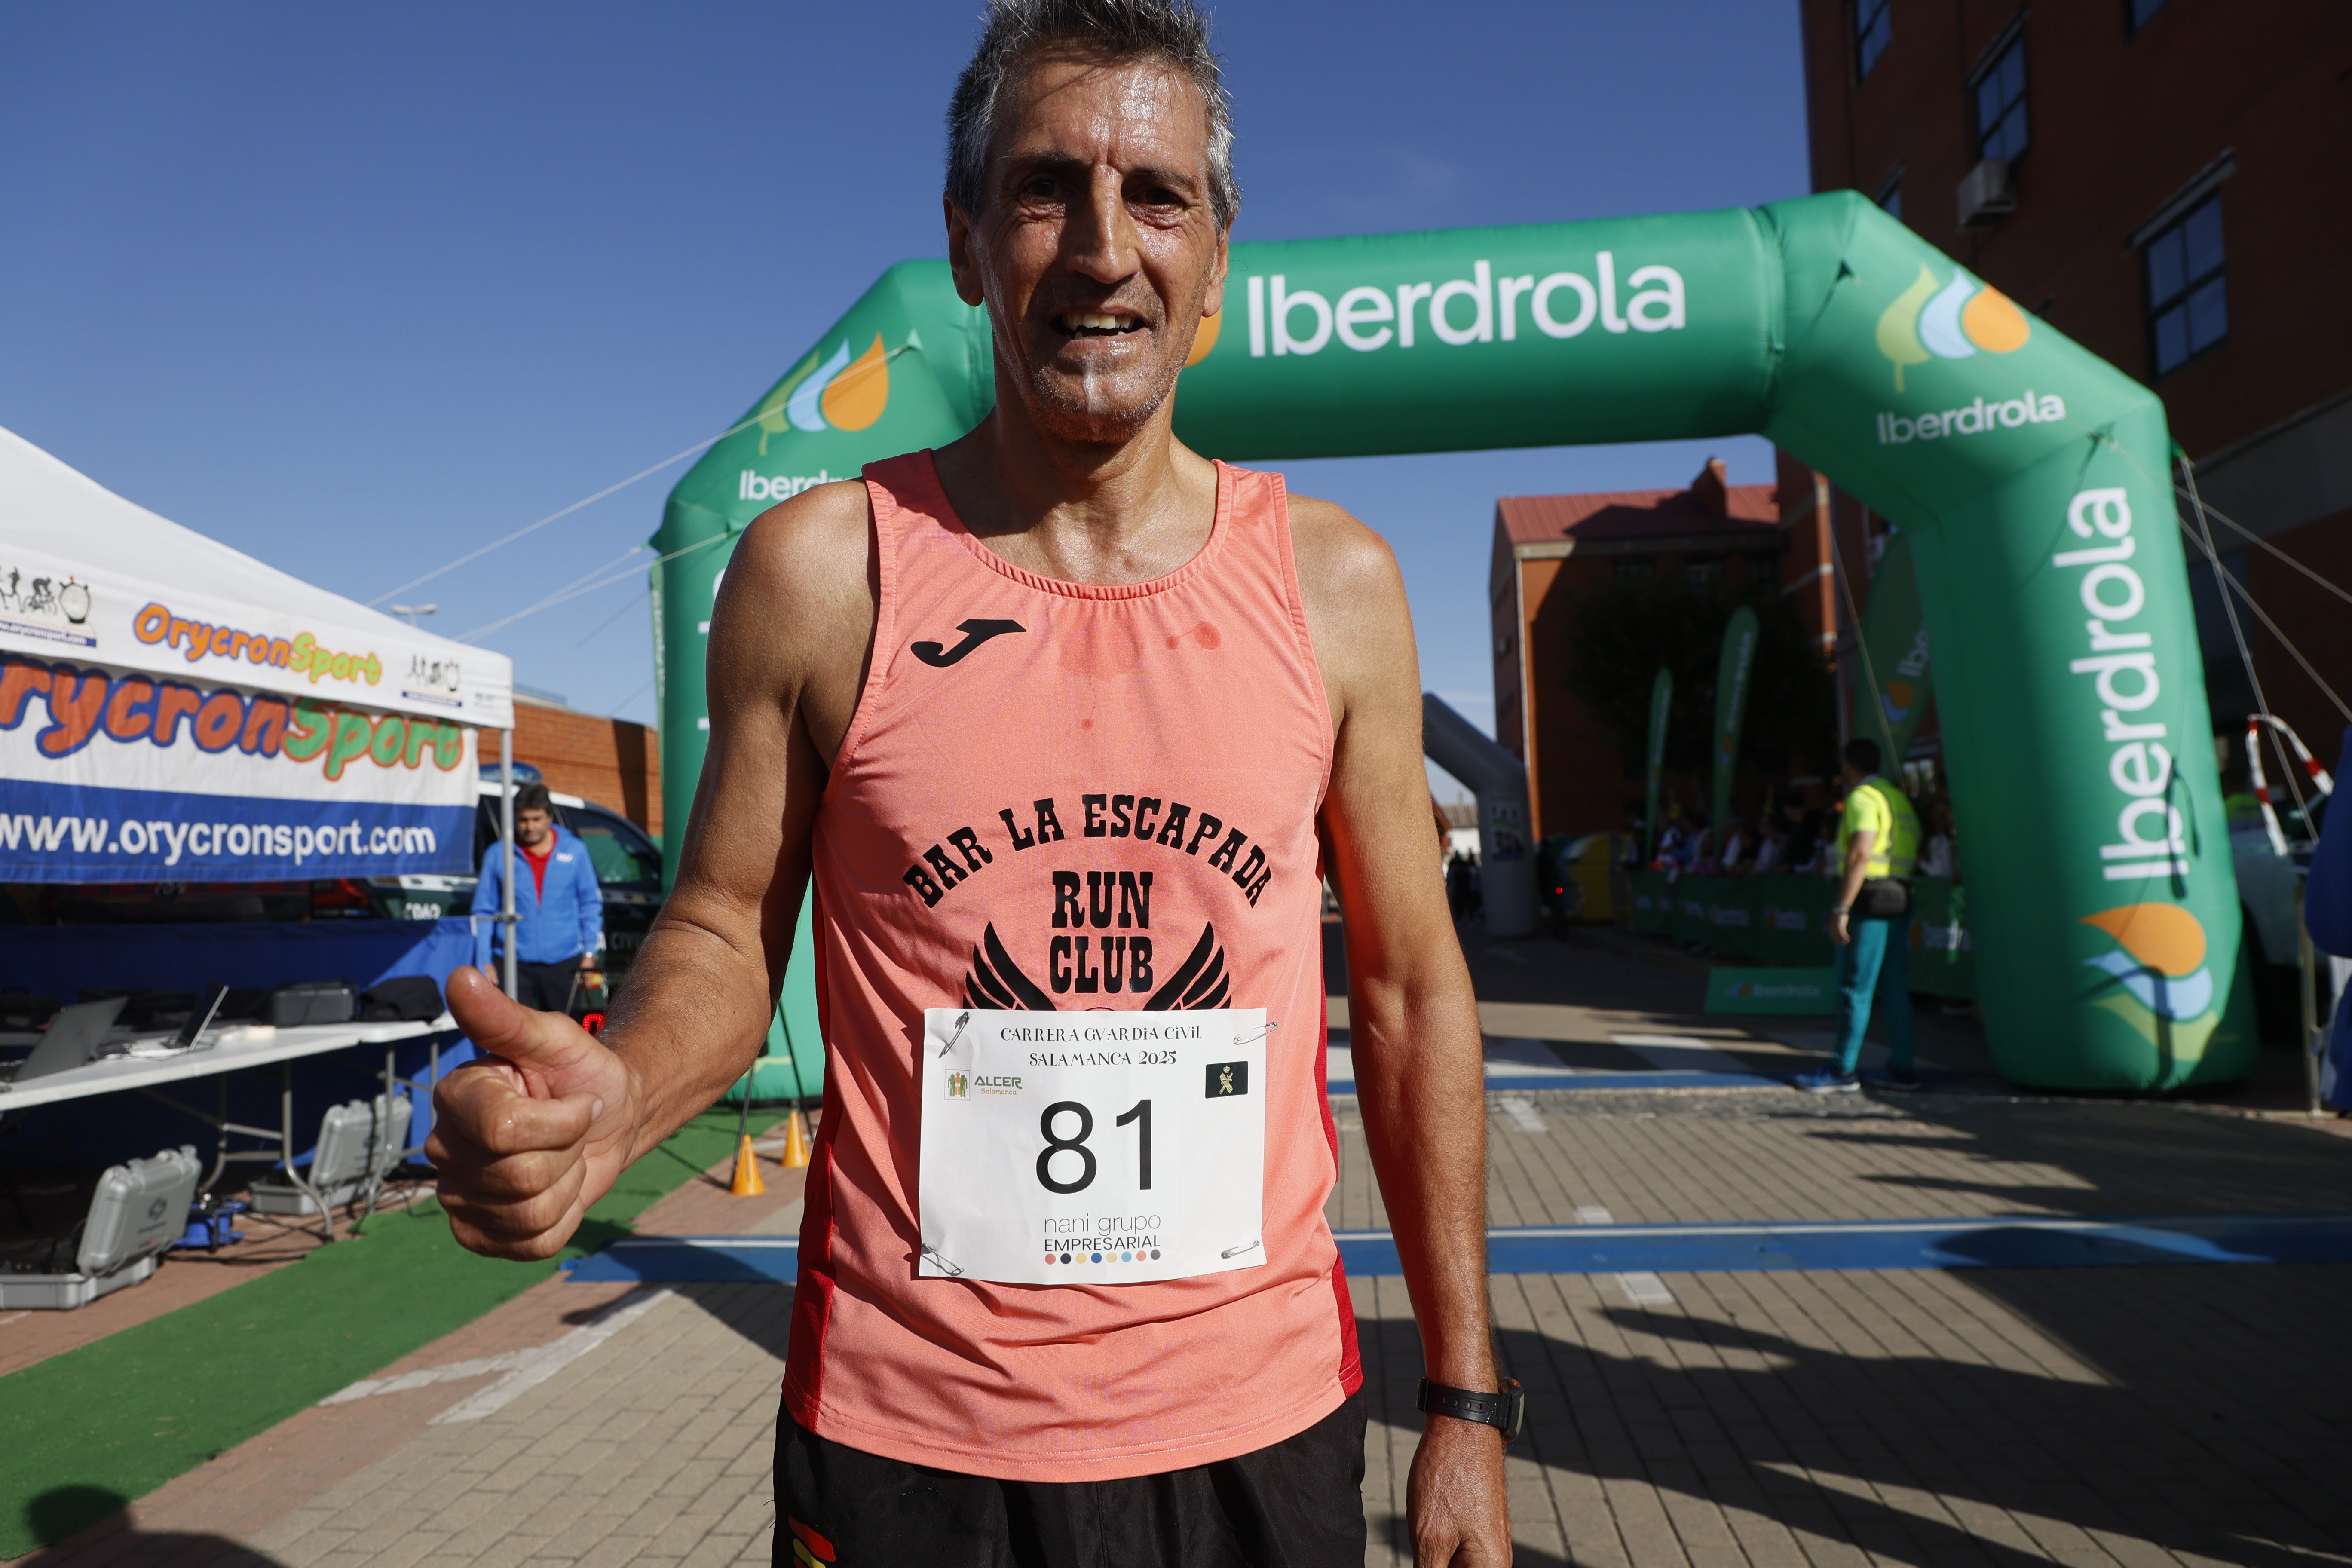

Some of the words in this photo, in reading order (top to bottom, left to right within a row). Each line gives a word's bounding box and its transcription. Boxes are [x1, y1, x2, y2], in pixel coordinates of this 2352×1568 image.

[1247, 251, 1686, 357] Iberdrola
[1877, 389, 2066, 445] Iberdrola
[738, 469, 855, 502] Iberd
[134, 603, 381, 685] OrycronSport
[2052, 486, 2189, 880] Iberdrola
[902, 826, 993, 908] BAR
[999, 798, 1065, 851] LA
[1081, 794, 1274, 908] ESCAPADA
[1051, 871, 1153, 930] RUN
[1050, 936, 1153, 994] CLUB
[1001, 1028, 1079, 1042] CARRERA
[1029, 1052, 1131, 1066] SALAMANCA
[1139, 1050, 1177, 1065] 2025
[974, 1075, 1023, 1089] ALCER
[980, 1087, 1018, 1096] Salamanca
[1036, 1099, 1152, 1194] 81
[1044, 1213, 1089, 1233] nani
[1098, 1215, 1161, 1236] grupo
[1044, 1235, 1161, 1251] EMPRESARIAL
